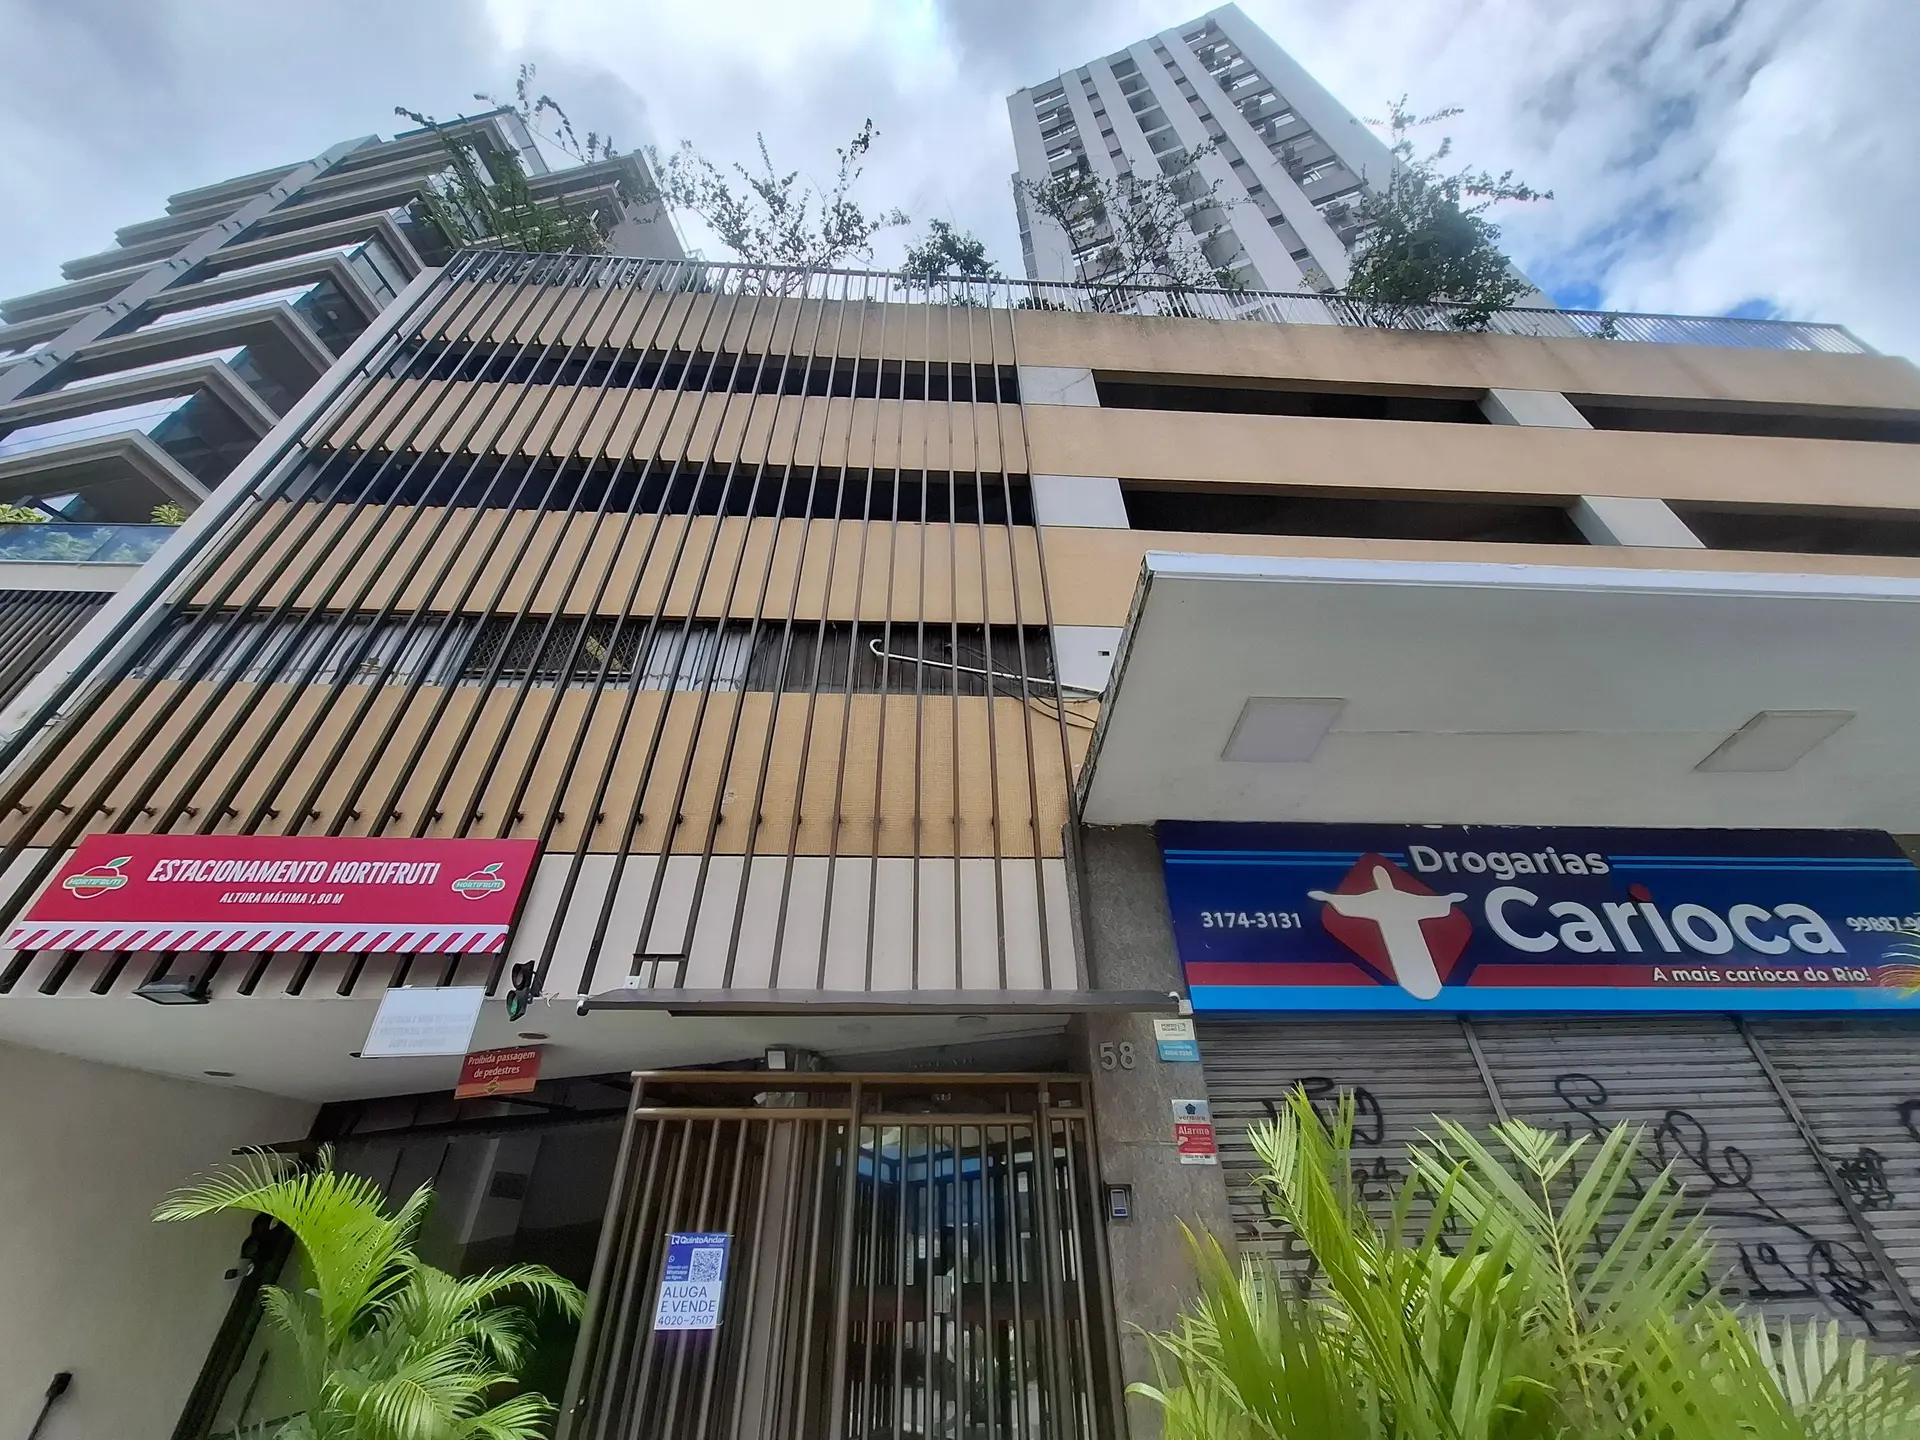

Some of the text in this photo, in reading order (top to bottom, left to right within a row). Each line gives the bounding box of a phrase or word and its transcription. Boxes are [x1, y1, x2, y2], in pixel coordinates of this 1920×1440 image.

[1408, 845, 1610, 880] Drogarias
[146, 859, 442, 885] ESTACIONAMENTO HORTIFRUTI
[219, 892, 261, 904] ALTURA
[261, 890, 308, 904] MÁXIMA
[1200, 911, 1302, 929] 3174-3131
[1484, 883, 1848, 956] Carioca
[1653, 966, 1872, 982] A mais carioca do Rio!
[468, 1052, 536, 1065] Proibida passagem
[1099, 1041, 1136, 1070] 58
[473, 1066, 521, 1079] de pedestres
[1178, 1125, 1210, 1135] Alarme
[680, 1236, 726, 1245] QuintoAndar
[663, 1286, 708, 1299] ALUGA
[660, 1300, 717, 1313] E VENDE
[658, 1315, 714, 1326] 4020-2507
